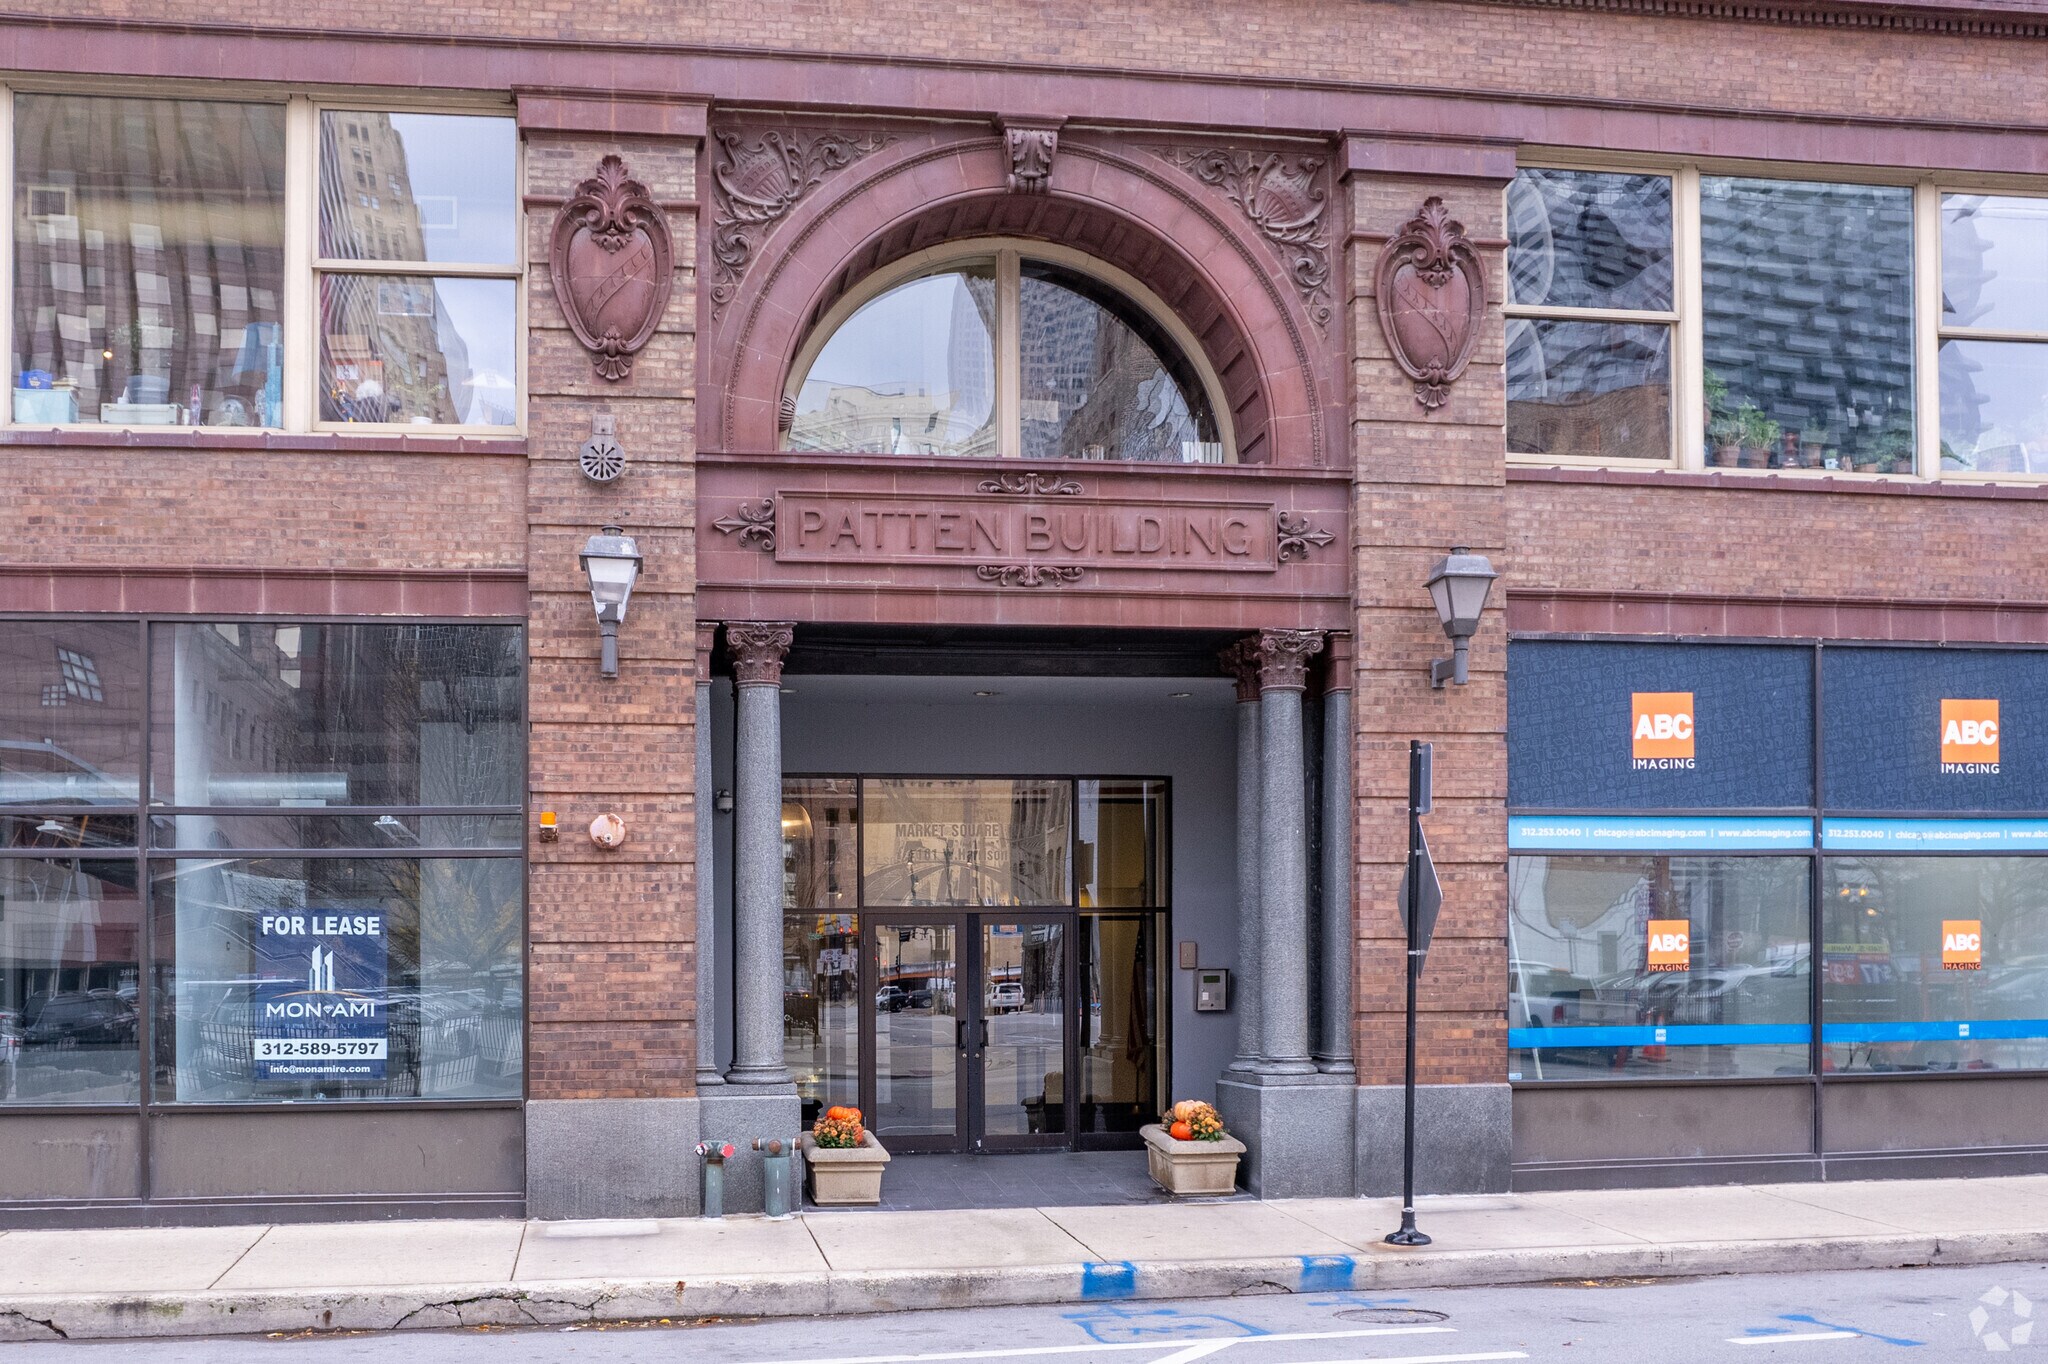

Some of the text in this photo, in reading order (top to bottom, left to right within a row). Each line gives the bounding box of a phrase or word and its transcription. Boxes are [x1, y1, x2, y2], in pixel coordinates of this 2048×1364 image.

[799, 509, 1253, 555] PATTEN BUILDING
[1634, 713, 1692, 740] ABC
[1942, 719, 1998, 746] ABC
[1632, 758, 1696, 770] IMAGING
[1941, 763, 2000, 775] IMAGING
[895, 824, 999, 838] MARKET SQUARE
[1521, 827, 1811, 839] 312.253.0040 chicago@abcimaging.com www.abcimaging.com
[1828, 829, 1885, 839] 312.253.0040
[262, 916, 380, 936] FOR LEASE
[1649, 933, 1688, 952] ABC
[1943, 933, 1980, 952] ABC
[1648, 964, 1690, 972] IMAGING
[1942, 962, 1981, 970] IMAGING
[266, 1002, 375, 1018] MON AMI
[262, 1043, 379, 1055] 312-589-5797
[270, 1065, 371, 1074] info@monamire.com
